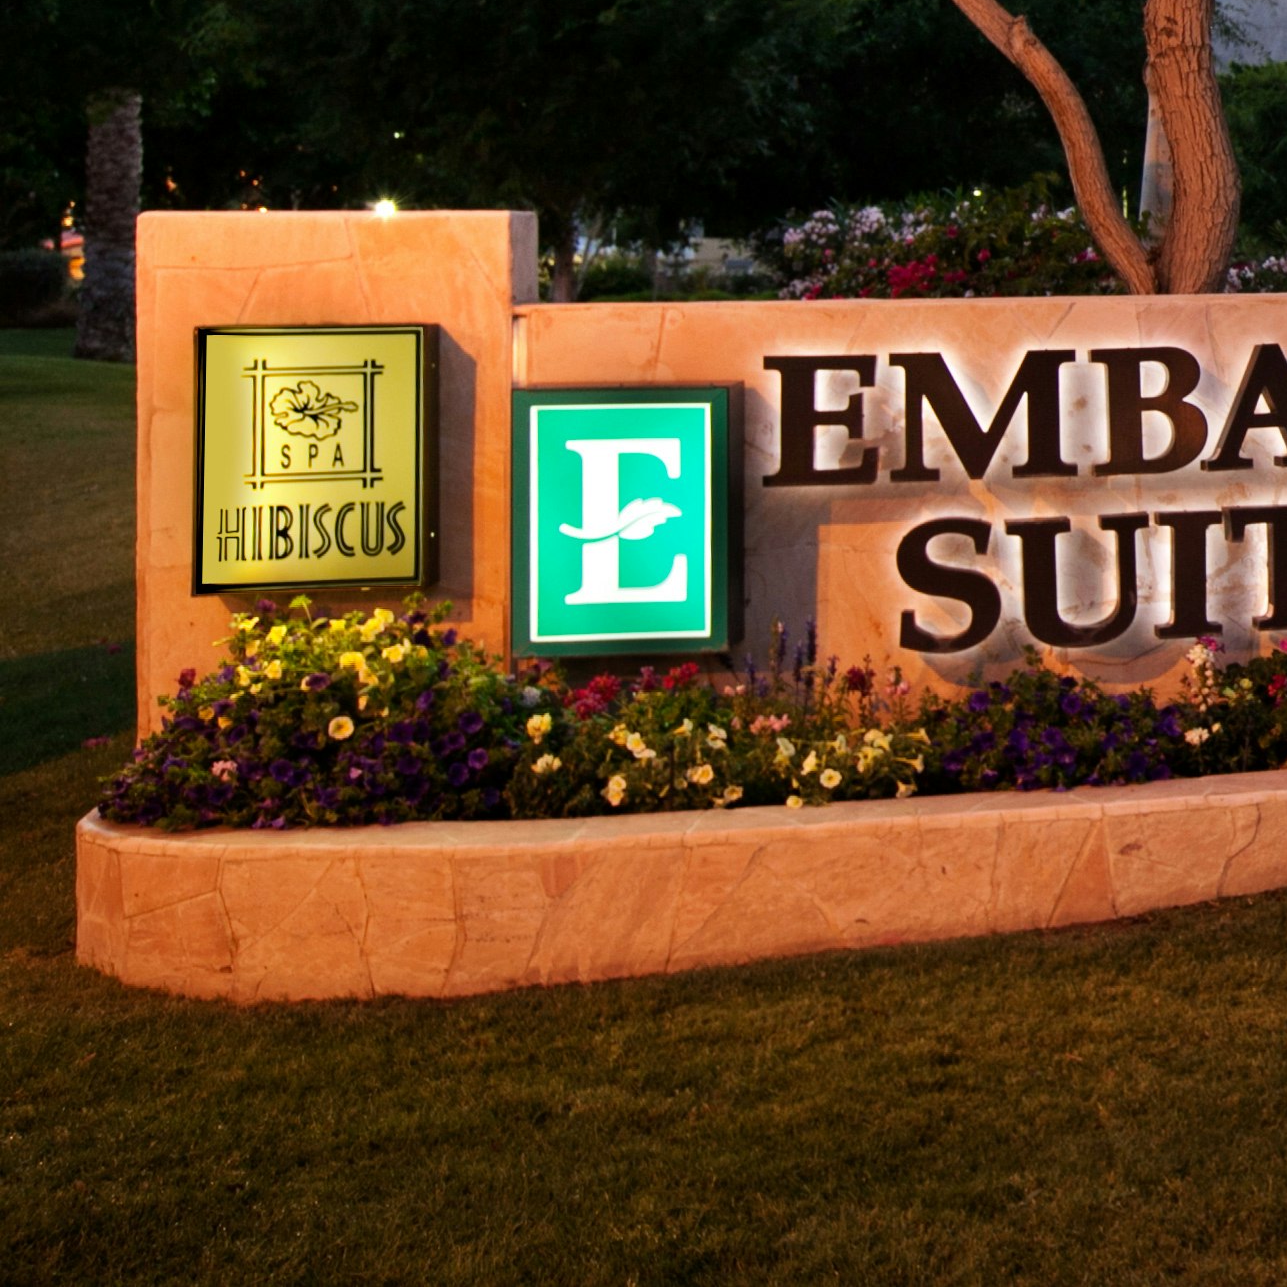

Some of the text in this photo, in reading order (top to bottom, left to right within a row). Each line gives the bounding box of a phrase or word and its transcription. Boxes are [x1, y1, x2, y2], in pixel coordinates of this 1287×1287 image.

[280, 443, 344, 469] SPA
[216, 501, 406, 562] HIBISCUS
[559, 438, 688, 605] E
